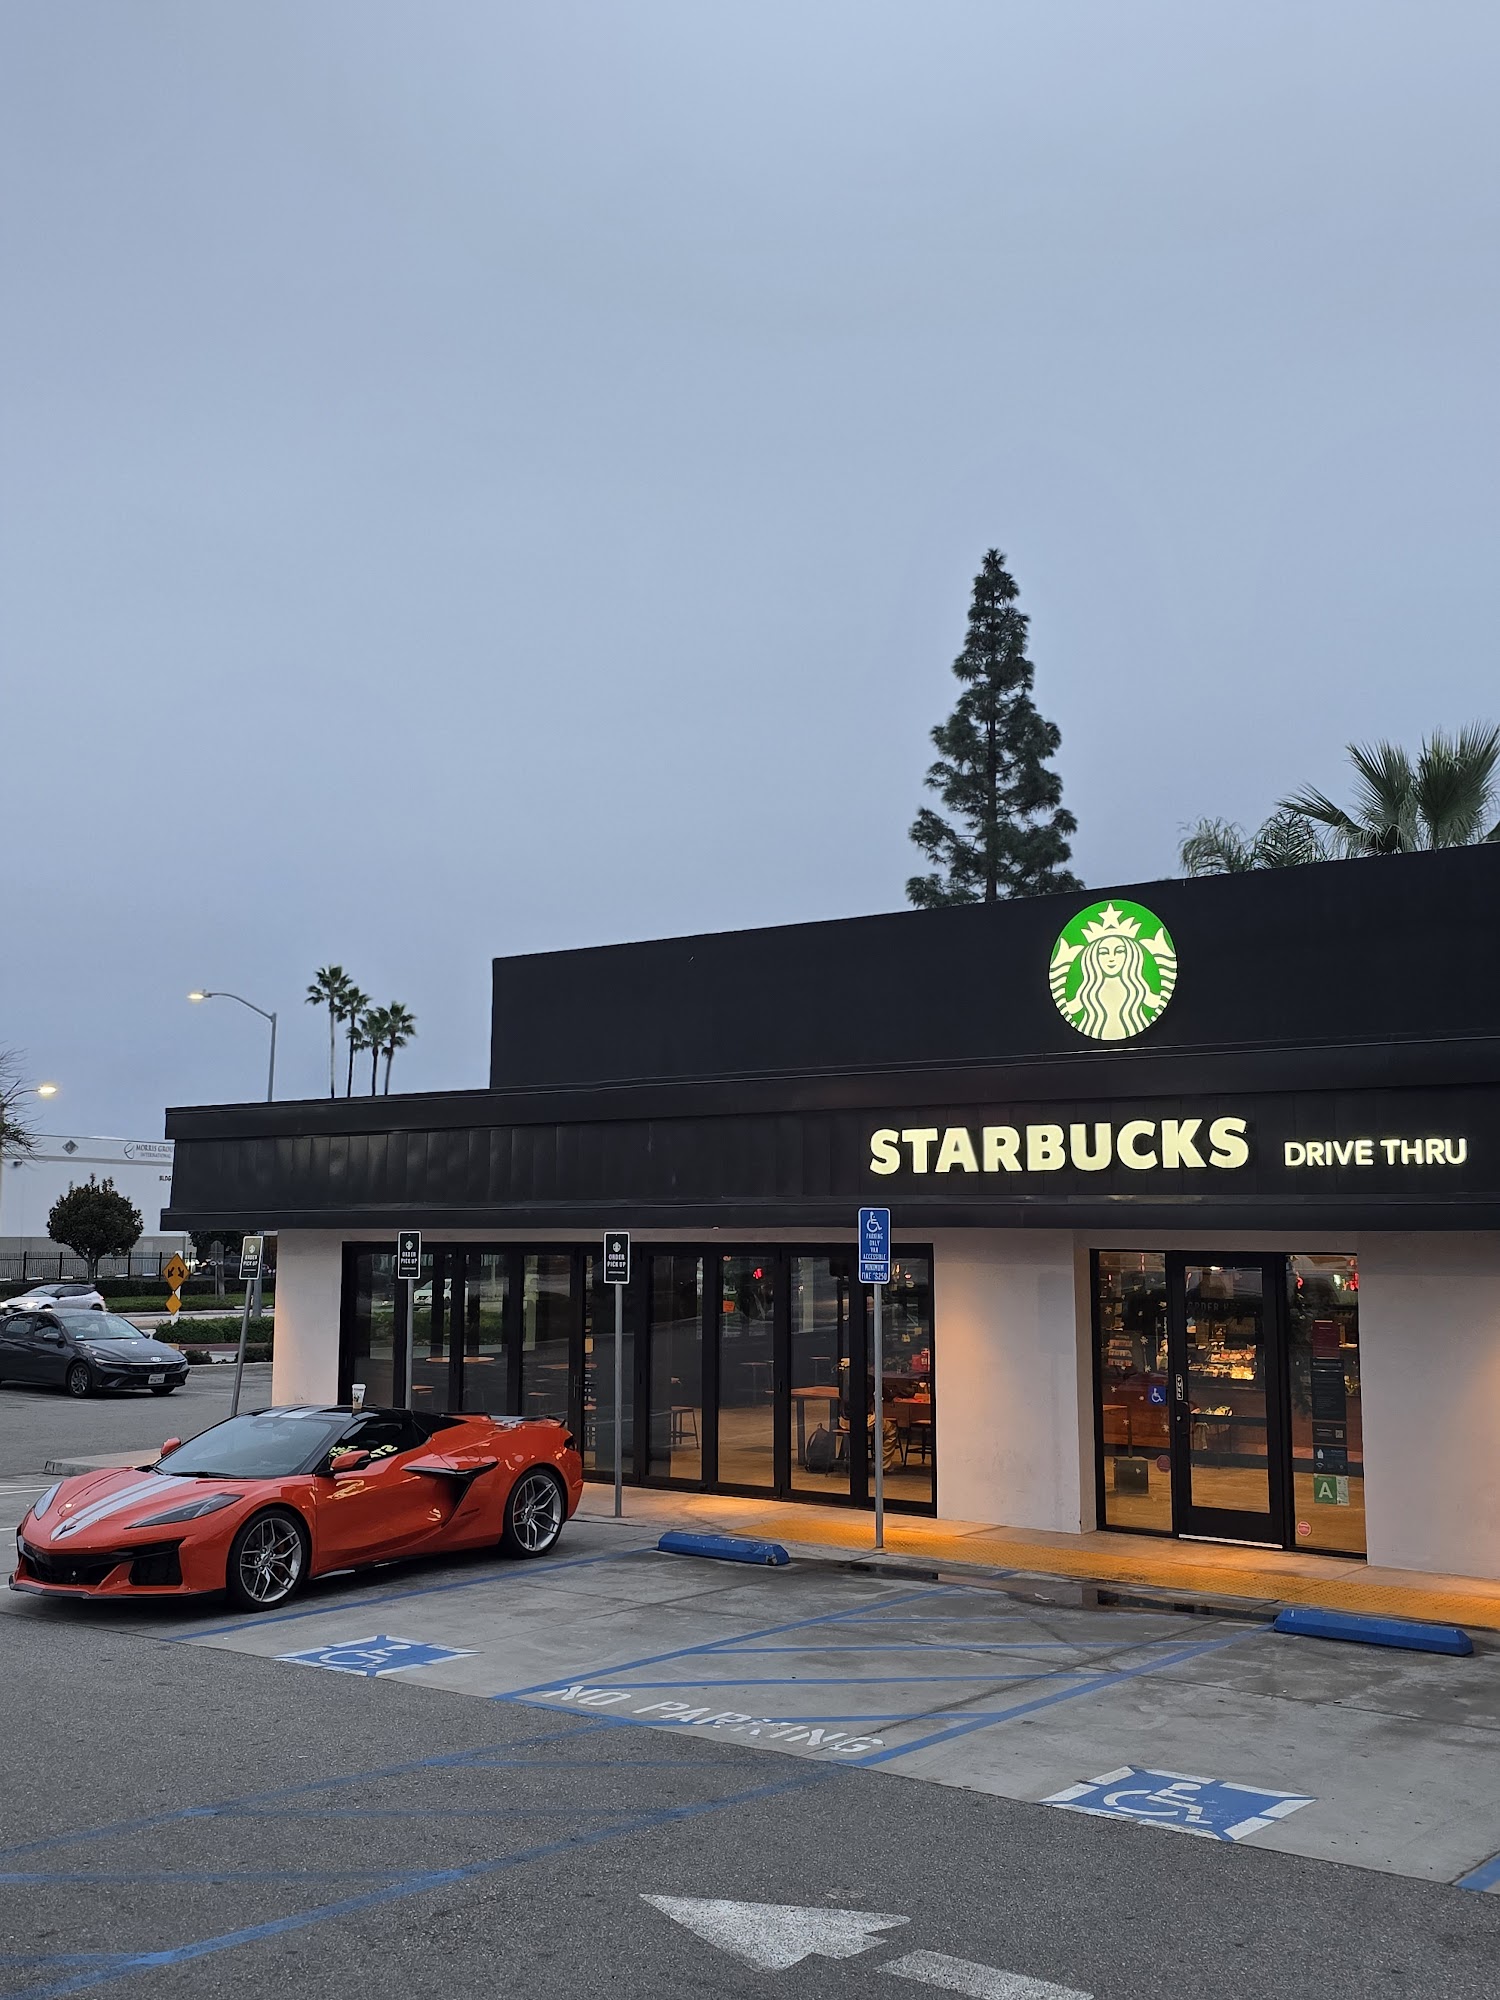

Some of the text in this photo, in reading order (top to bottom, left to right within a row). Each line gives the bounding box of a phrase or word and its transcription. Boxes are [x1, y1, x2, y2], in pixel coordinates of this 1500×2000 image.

[136, 1144, 174, 1153] MORRIS GROU
[869, 1116, 1249, 1175] STARBUCKS
[1284, 1137, 1468, 1167] DRIVE THRU
[1318, 1481, 1334, 1499] A
[541, 1685, 884, 1753] NO PARKING
